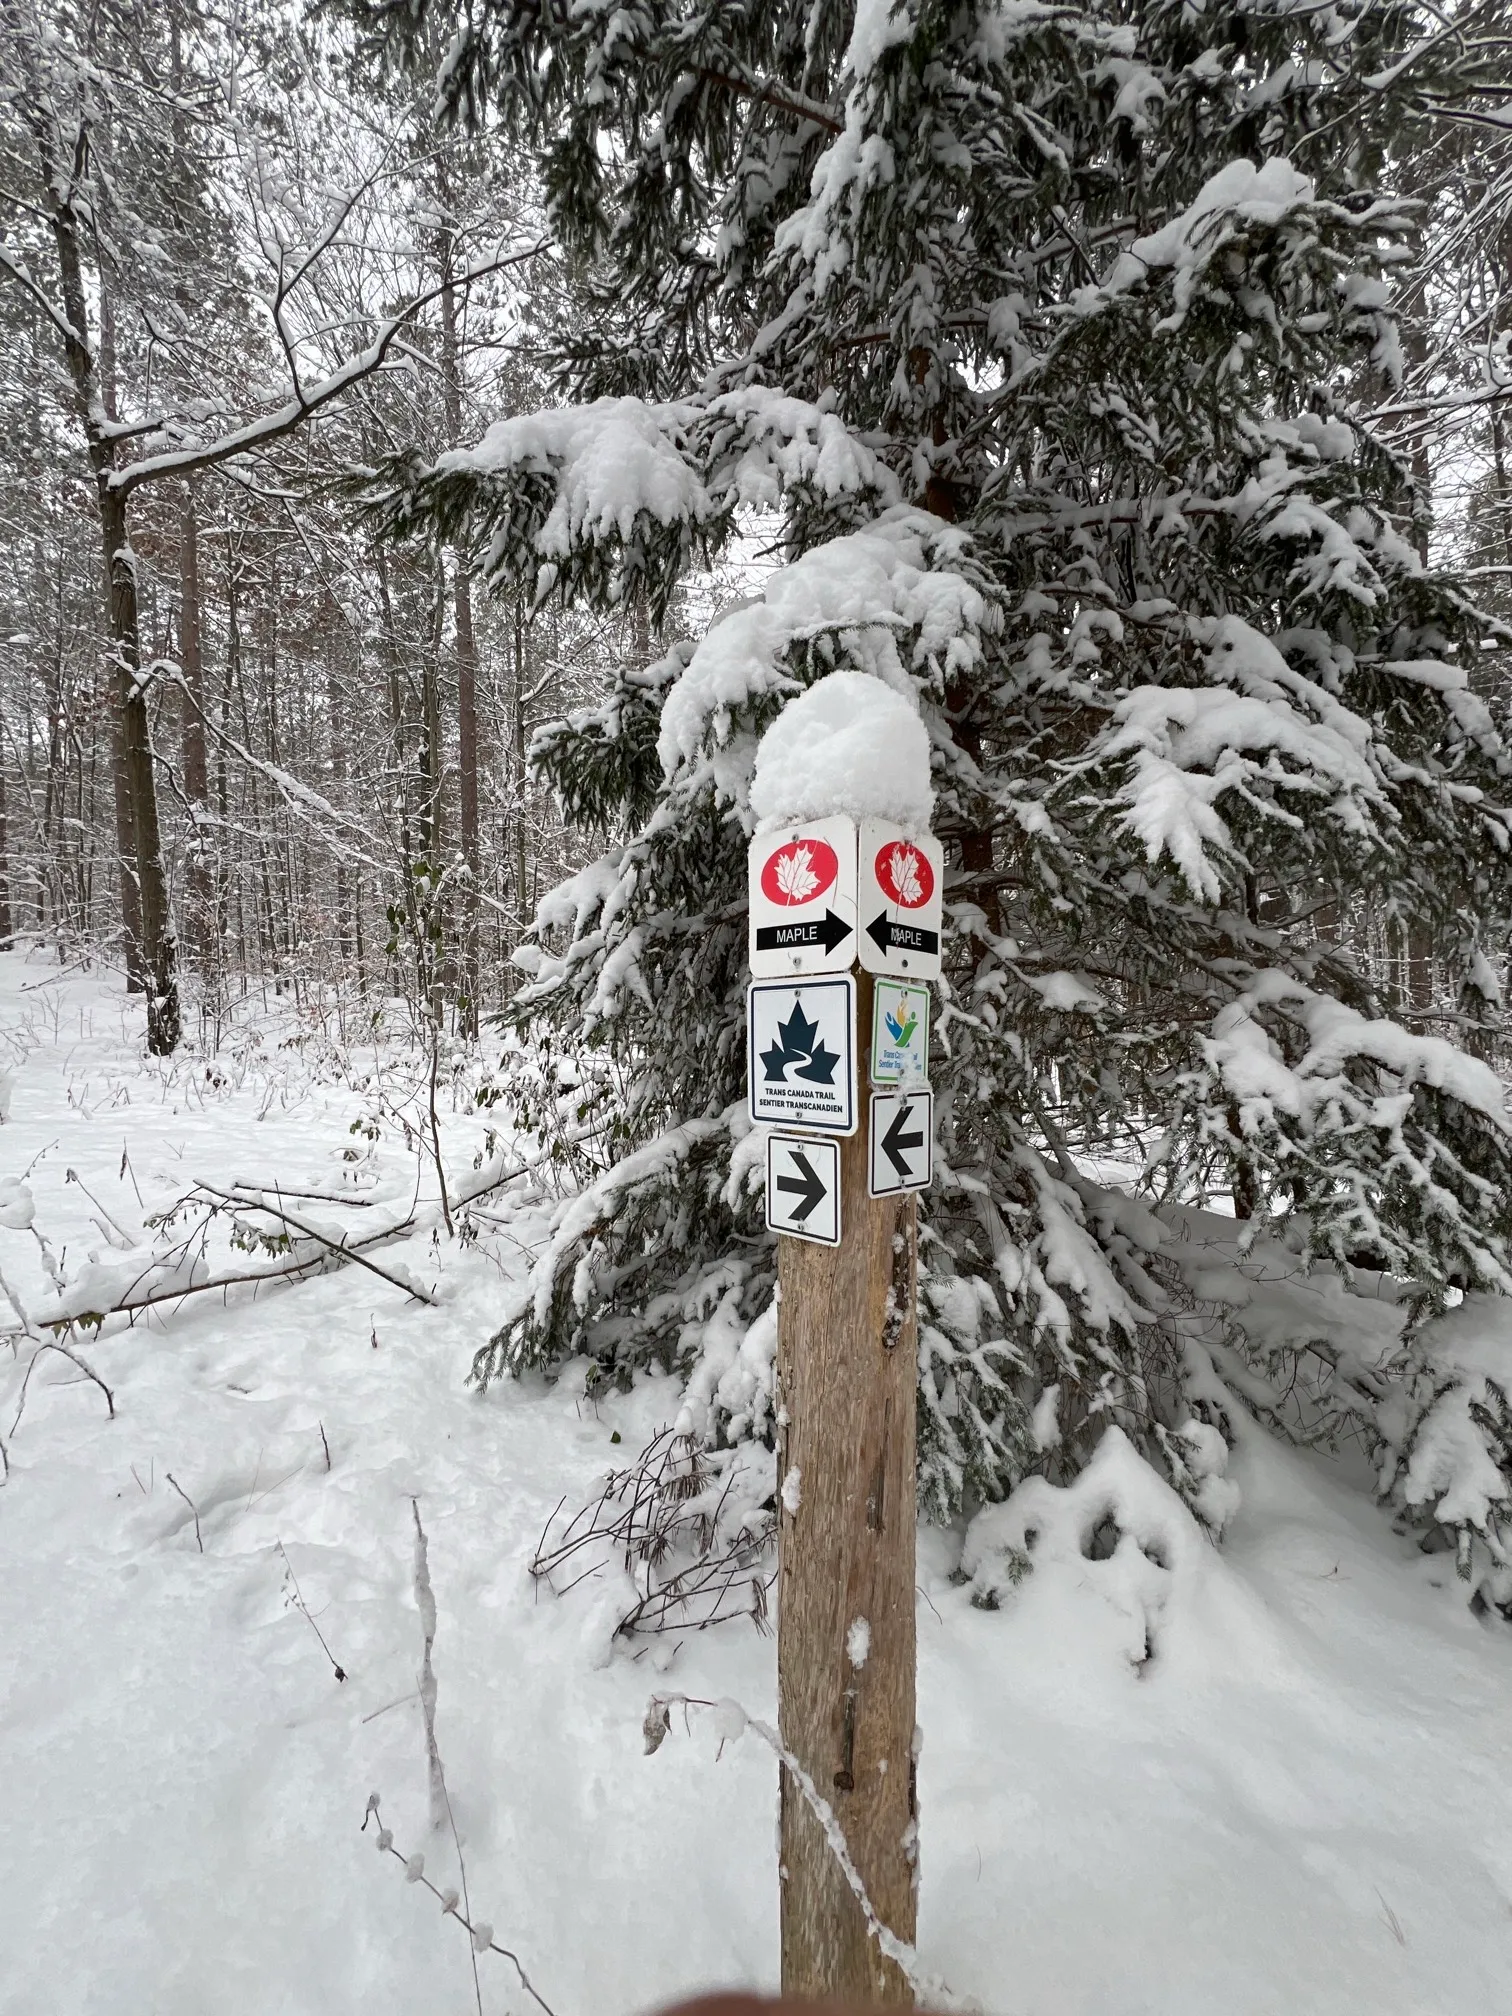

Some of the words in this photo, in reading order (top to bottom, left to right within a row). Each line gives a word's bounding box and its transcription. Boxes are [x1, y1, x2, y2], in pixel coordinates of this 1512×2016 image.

[776, 925, 818, 943] MAPLE
[890, 927, 922, 946] MAPLE
[765, 1087, 786, 1096] TRANS
[787, 1089, 814, 1099] CANADA
[815, 1091, 836, 1100] TRAIL
[759, 1098, 785, 1108] SENTIER
[786, 1100, 843, 1113] TRANSCANADIEN
